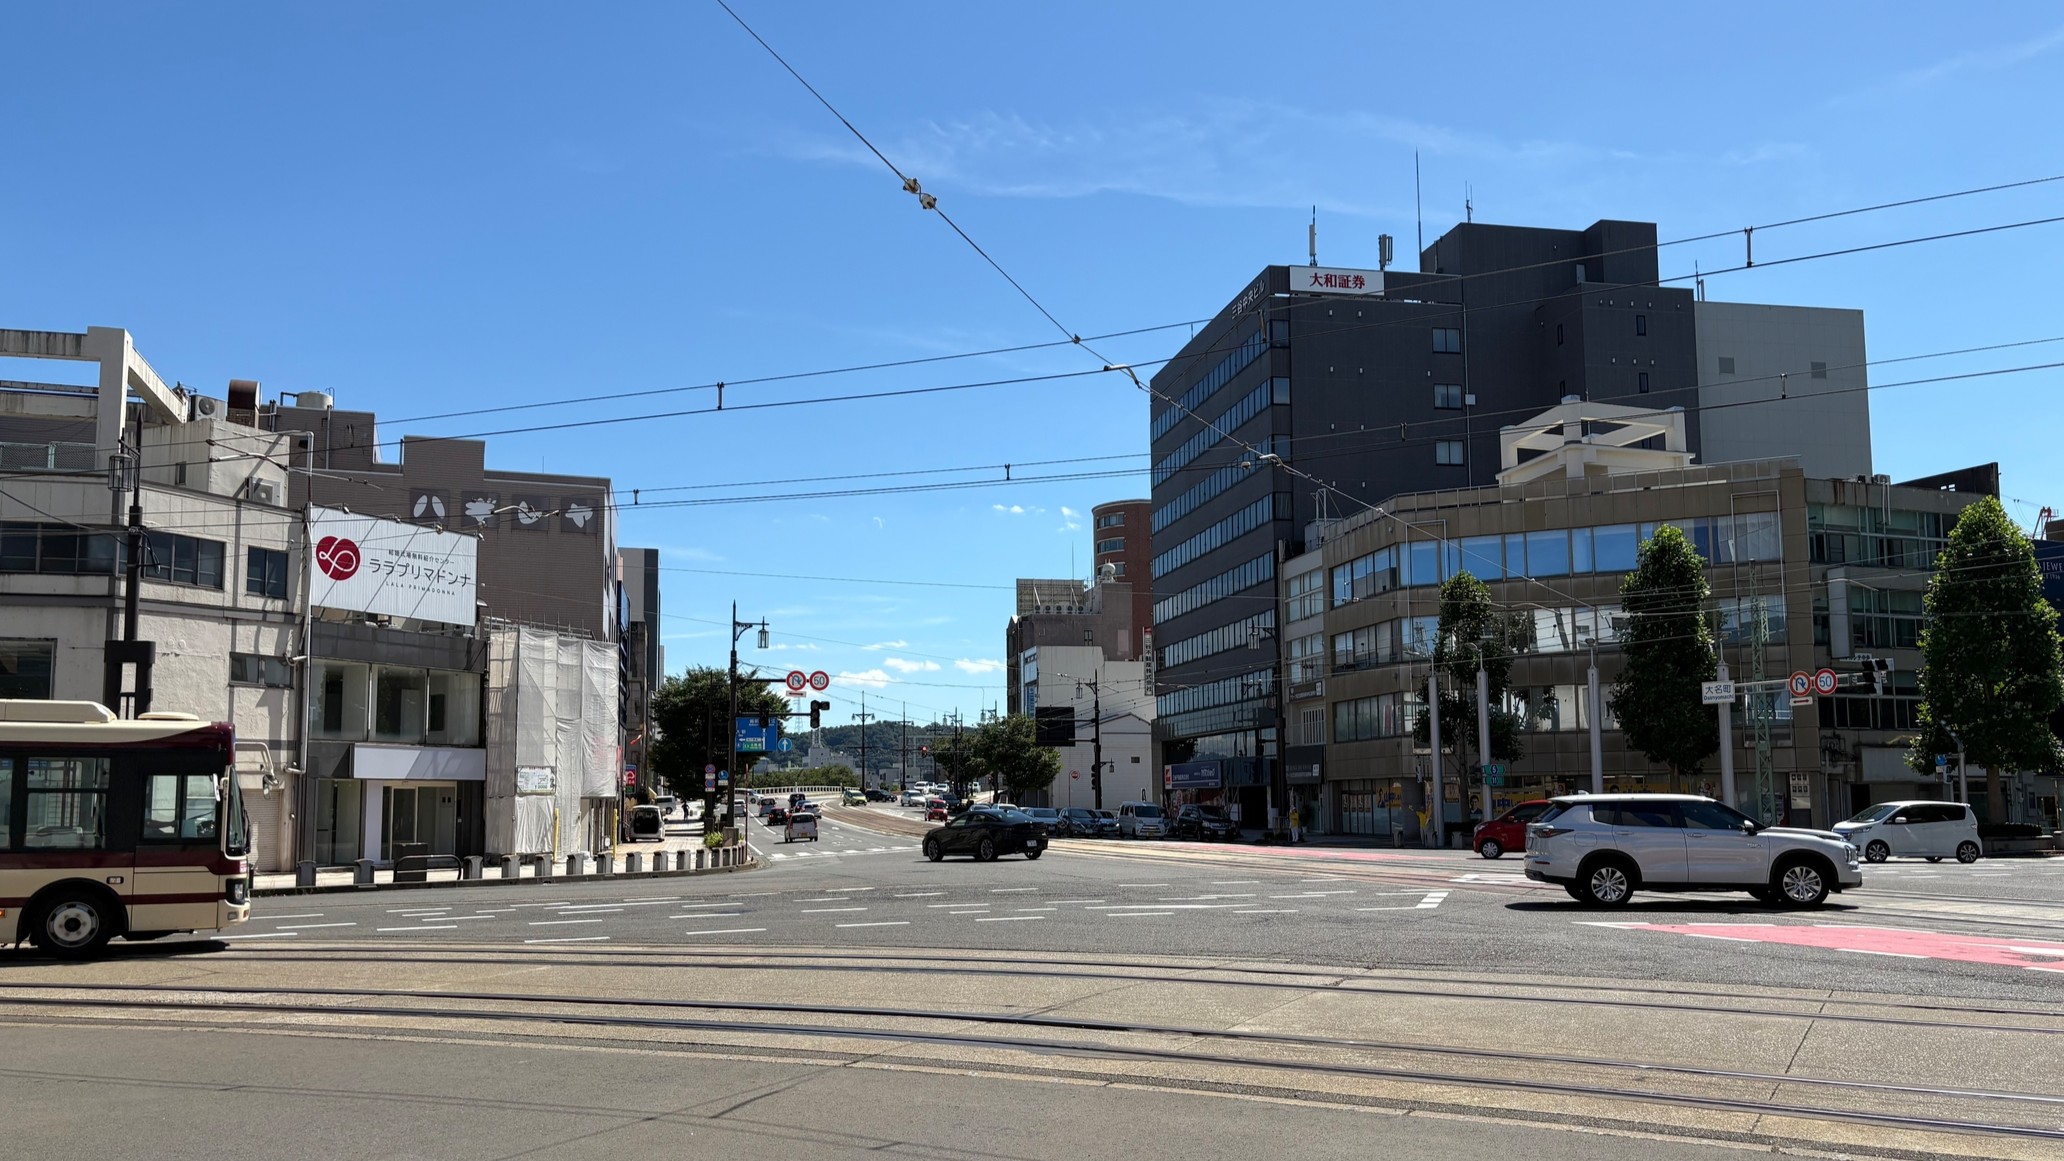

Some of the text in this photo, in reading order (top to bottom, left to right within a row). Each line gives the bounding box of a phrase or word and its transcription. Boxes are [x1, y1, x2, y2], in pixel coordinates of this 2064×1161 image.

[1310, 272, 1366, 290] 大和証券
[1231, 279, 1265, 320] 三谷中央ビル
[369, 558, 471, 587] ララプリマドンナ
[408, 586, 455, 596] PRIMADONNA
[1705, 684, 1731, 694] 大名町
[1819, 676, 1832, 688] 50
